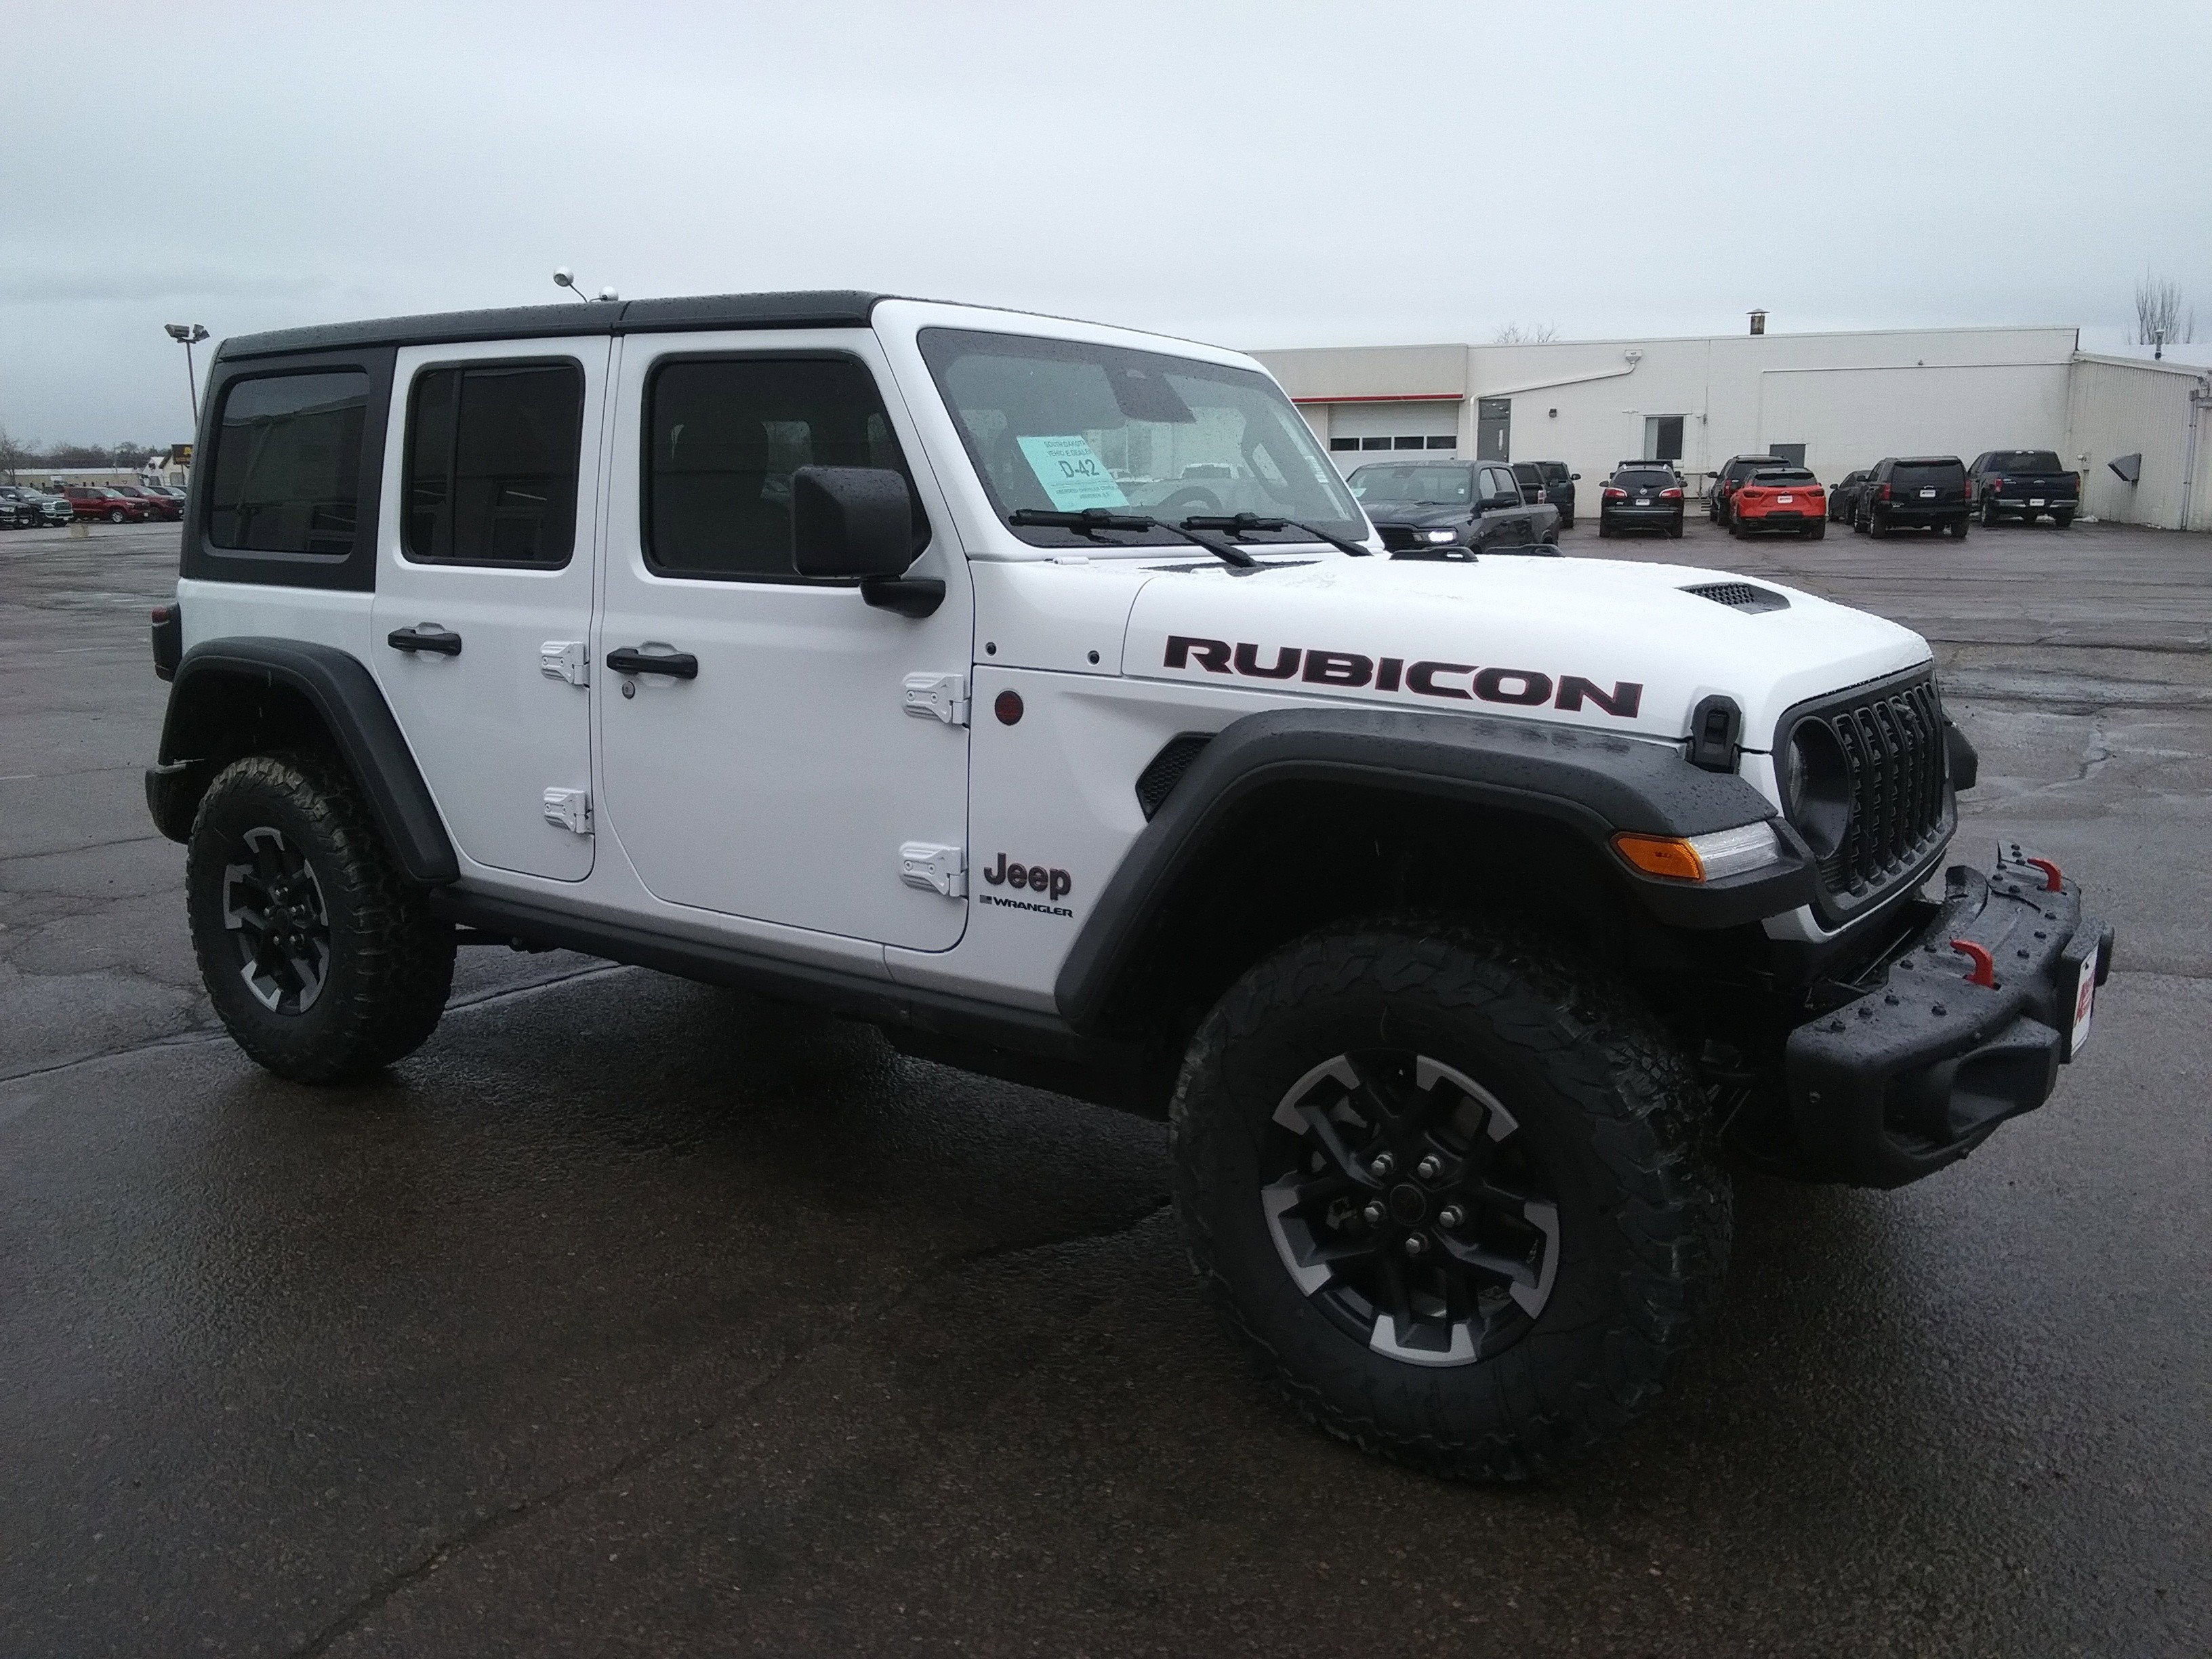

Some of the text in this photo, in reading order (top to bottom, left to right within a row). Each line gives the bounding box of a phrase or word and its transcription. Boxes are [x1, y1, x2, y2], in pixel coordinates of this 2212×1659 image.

[1058, 458, 1100, 478] D-42
[1163, 635, 1643, 718] RUBICON
[983, 852, 1071, 901] Jeep
[993, 896, 1073, 918] WRANGLER
